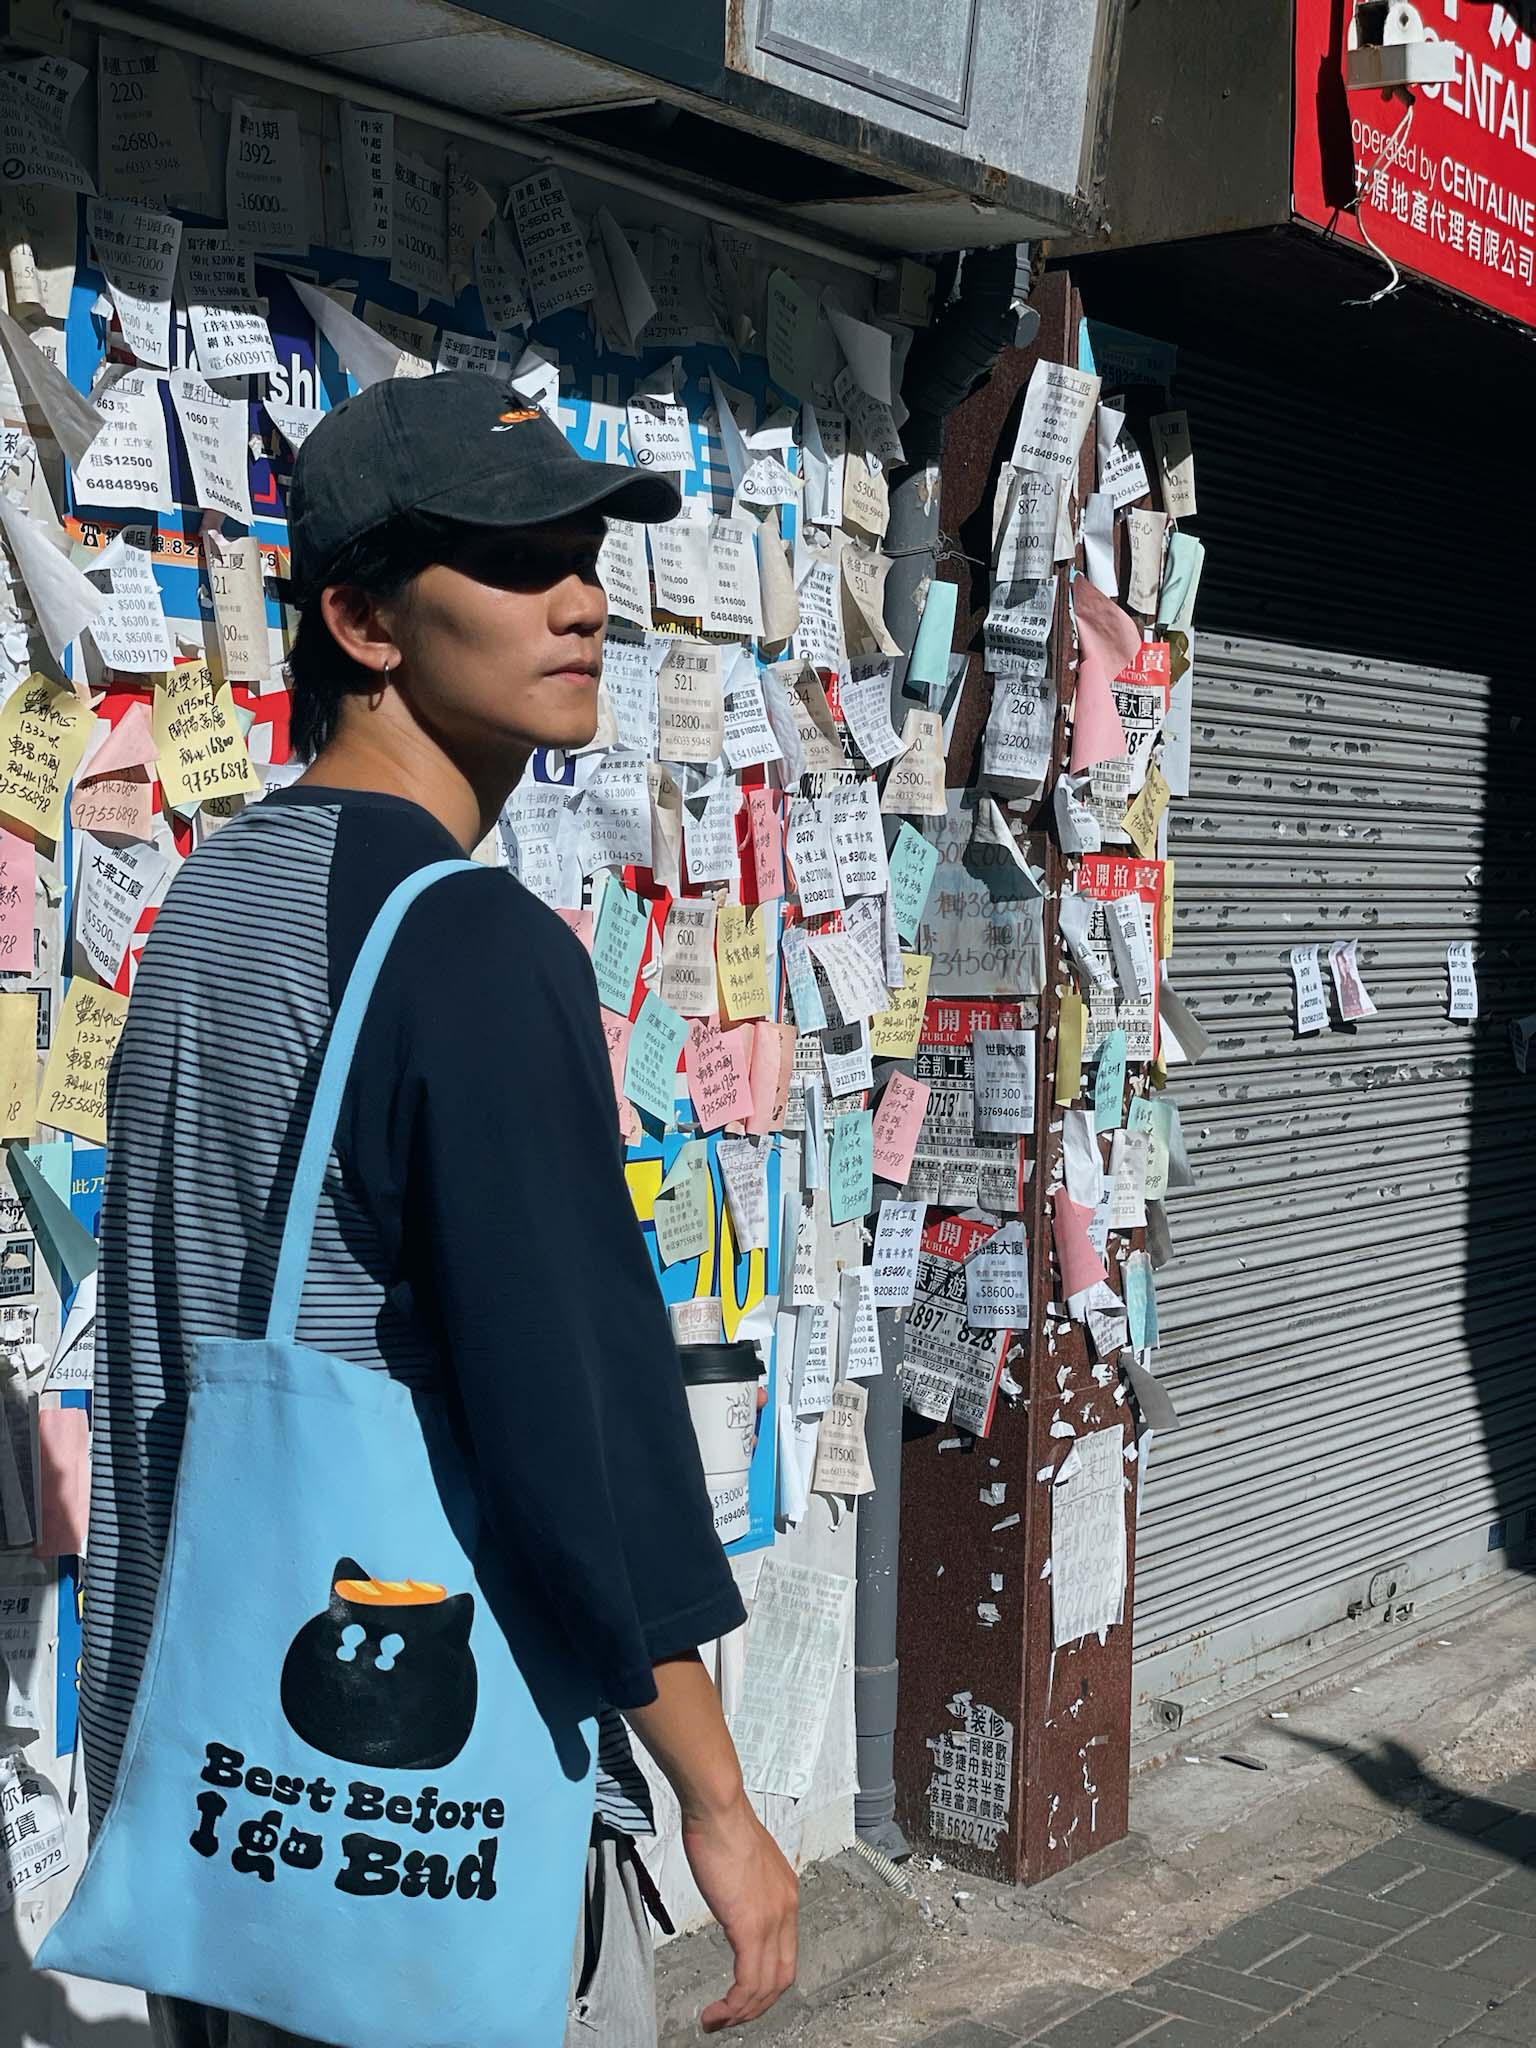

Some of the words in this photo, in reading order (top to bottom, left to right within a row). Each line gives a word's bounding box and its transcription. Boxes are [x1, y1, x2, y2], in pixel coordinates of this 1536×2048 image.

[111, 81, 144, 103] 220
[1351, 119, 1416, 173] operated
[1420, 148, 1438, 191] by
[1441, 156, 1535, 238] CENTALINE
[181, 382, 232, 408] 豐利中心
[184, 410, 209, 426] 1060
[89, 453, 154, 469] 租$12500
[1020, 444, 1074, 466] 64848996
[86, 477, 160, 494] 64848996
[710, 611, 754, 624] 64848996
[112, 649, 168, 664] 68039179
[674, 673, 693, 691] 521
[1011, 700, 1035, 717] 260
[670, 713, 700, 729] 12800
[1002, 733, 1031, 750] 3200
[181, 760, 249, 794] 97556898
[895, 771, 924, 786] 5500
[75, 803, 139, 828] 97556898
[92, 855, 144, 900] 大眾工廈
[1079, 863, 1161, 891] 公開拍賣
[87, 908, 113, 944] $5500
[677, 929, 694, 946] 600
[675, 969, 695, 984] 8000
[921, 1031, 957, 1044] PUBLIC
[984, 1087, 1021, 1101] $11300
[977, 1106, 1021, 1119] 93769406
[873, 1286, 910, 1297] 82082102
[980, 1285, 1015, 1299] $8600
[972, 1304, 1017, 1317] 67176653
[55, 1367, 95, 1380] 541044
[831, 1410, 853, 1427] 1195
[829, 1446, 855, 1463] 17500
[713, 1505, 747, 1528] 3769406
[953, 1745, 968, 1811] 捷妥當
[200, 1742, 337, 1813] Best
[344, 1781, 505, 1834] Before
[947, 1814, 975, 1842] 5622
[189, 1790, 227, 1857] I
[231, 1810, 323, 1882] go
[334, 1832, 498, 1901] Bad
[7, 1867, 32, 1894] 9121
[34, 1848, 63, 1875] 8779
